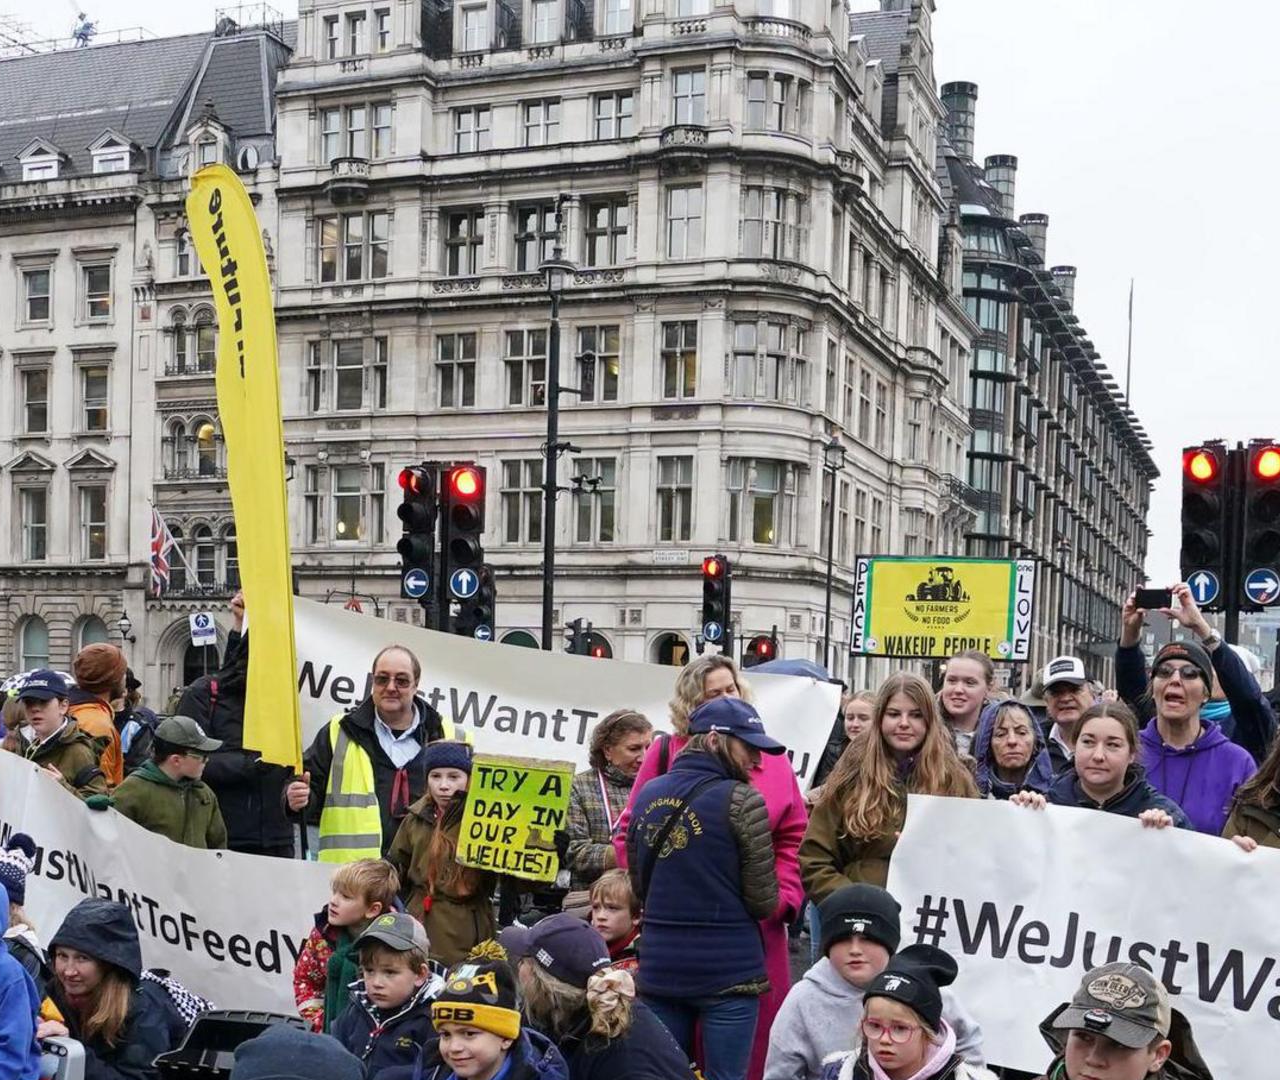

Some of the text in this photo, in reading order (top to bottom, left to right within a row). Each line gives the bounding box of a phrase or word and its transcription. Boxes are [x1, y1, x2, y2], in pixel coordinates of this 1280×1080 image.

[852, 562, 869, 649] PEACE
[915, 605, 959, 614] NO FARMERS
[1014, 574, 1030, 655] LOVE
[922, 616, 951, 625] NO FOOD
[884, 635, 936, 656] WAKEUP
[478, 767, 562, 797] TRY A
[473, 799, 564, 828] DAY IN
[470, 822, 517, 844] OUR
[466, 843, 553, 874] WELLIES!
